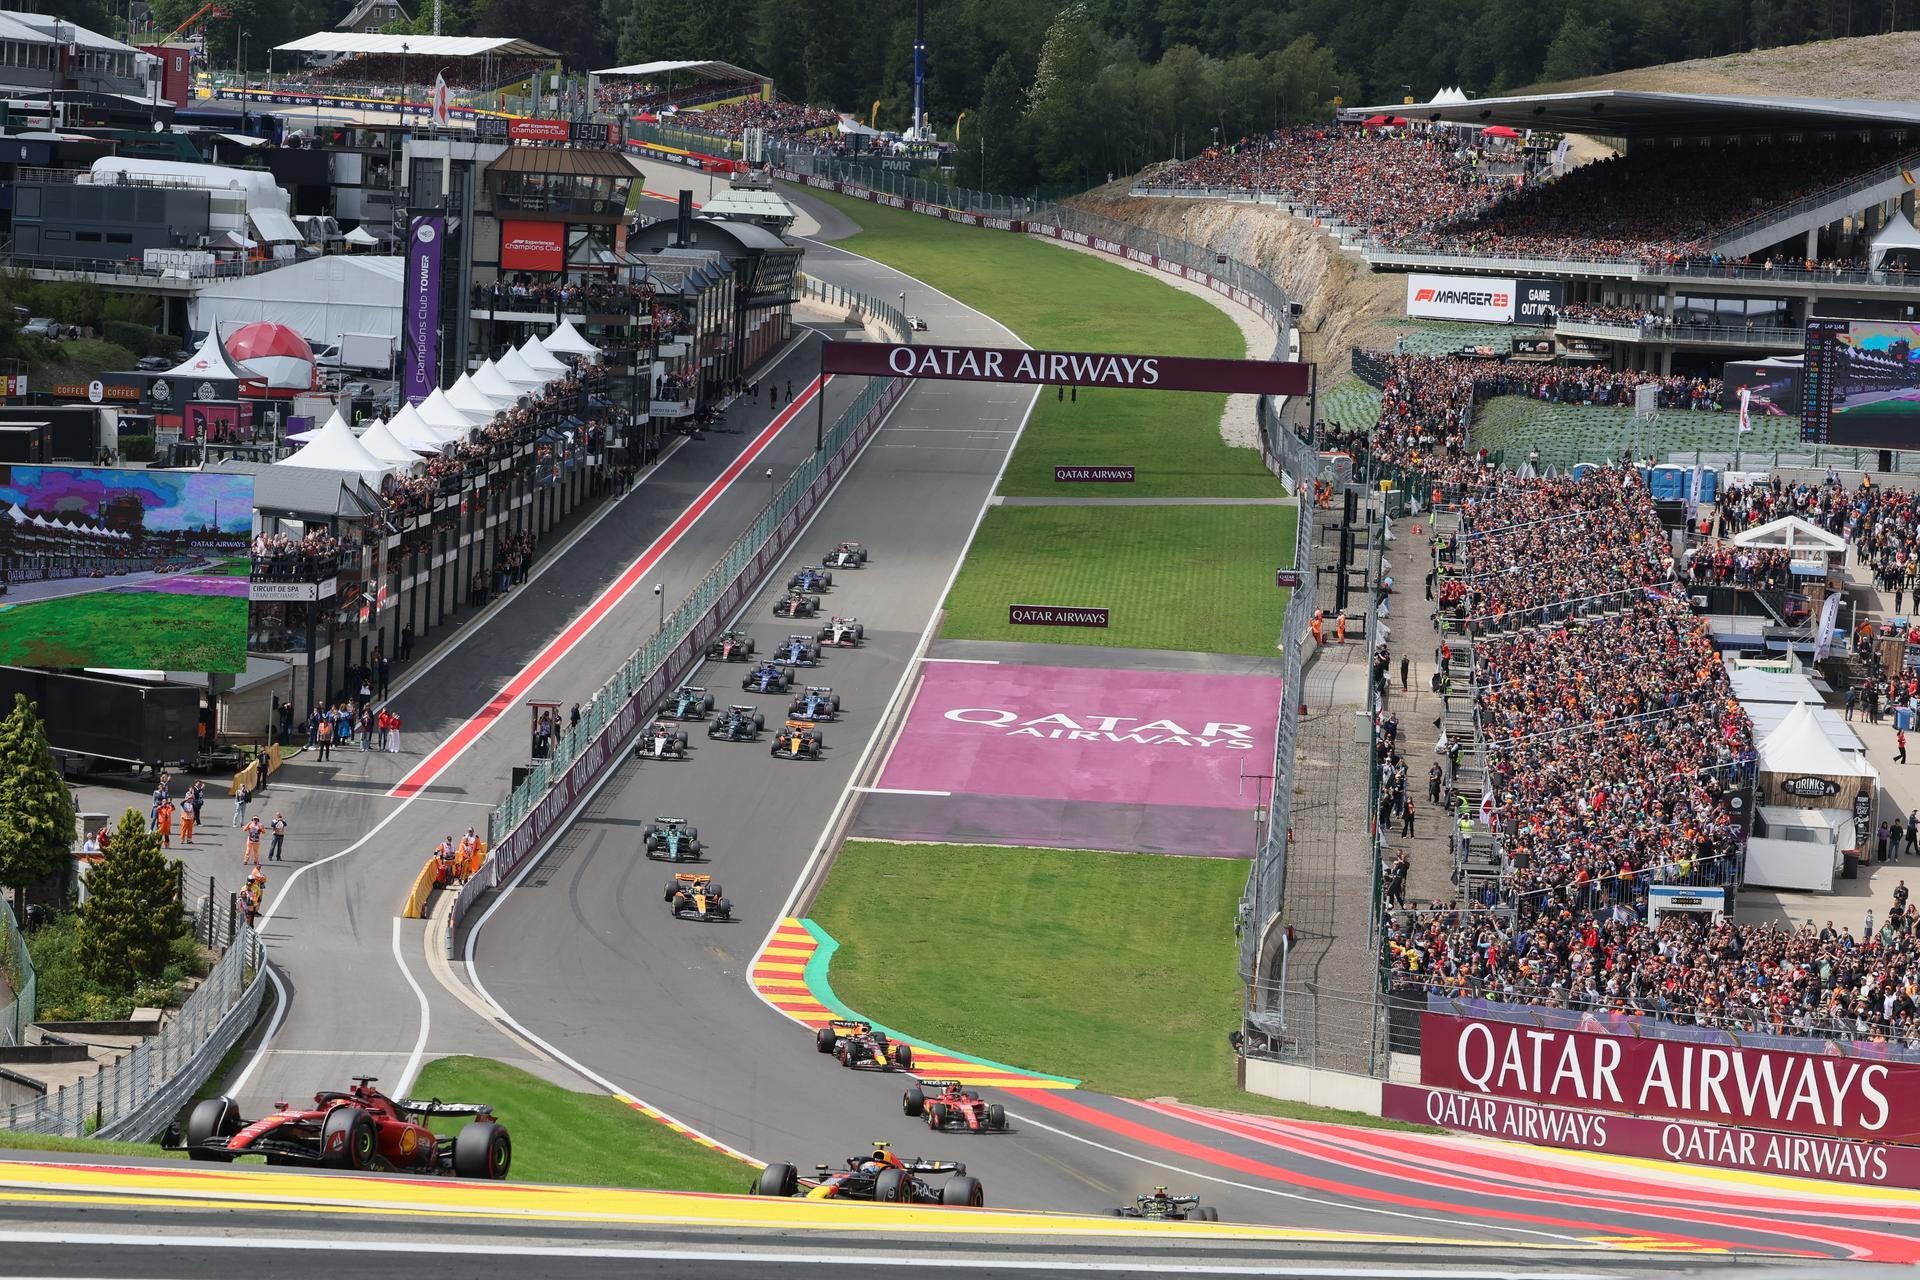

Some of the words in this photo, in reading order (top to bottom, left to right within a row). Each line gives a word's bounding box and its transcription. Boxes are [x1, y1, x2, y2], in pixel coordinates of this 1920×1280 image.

[511, 127, 550, 136] Champions
[550, 128, 566, 136] Club
[576, 124, 608, 140] 15:04
[882, 160, 911, 171] PMR
[505, 243, 545, 251] Champions
[420, 255, 430, 294] TOWER
[1528, 289, 1551, 301] GAME
[418, 295, 428, 320] Club
[1521, 303, 1536, 315] OUT
[416, 321, 427, 384] Champions
[889, 346, 1004, 378] QATAR
[1013, 353, 1159, 385] AIRWAYS
[58, 386, 84, 395] COFFEE
[107, 388, 134, 397] COFFEE
[1057, 470, 1090, 479] QATAR
[1091, 471, 1132, 479] AIRWAYS
[191, 540, 214, 548] QATAR
[253, 585, 276, 593] CIRCUIT
[1012, 610, 1052, 622] QATAR
[1055, 612, 1106, 624] AIRWAYS
[944, 708, 1254, 739] QATAR
[1006, 728, 1254, 750] AIRWAYS
[1795, 777, 1825, 791] DRINKS
[496, 838, 515, 882] QATAR
[1457, 1022, 1624, 1104] QATAR
[1639, 1043, 1889, 1131] AIRWAYS
[1426, 1090, 1498, 1132] QATAR
[1503, 1106, 1607, 1147] AIRWAYS
[1662, 1124, 1756, 1164] QATAR
[1763, 1136, 1888, 1181] AIRWAYS
